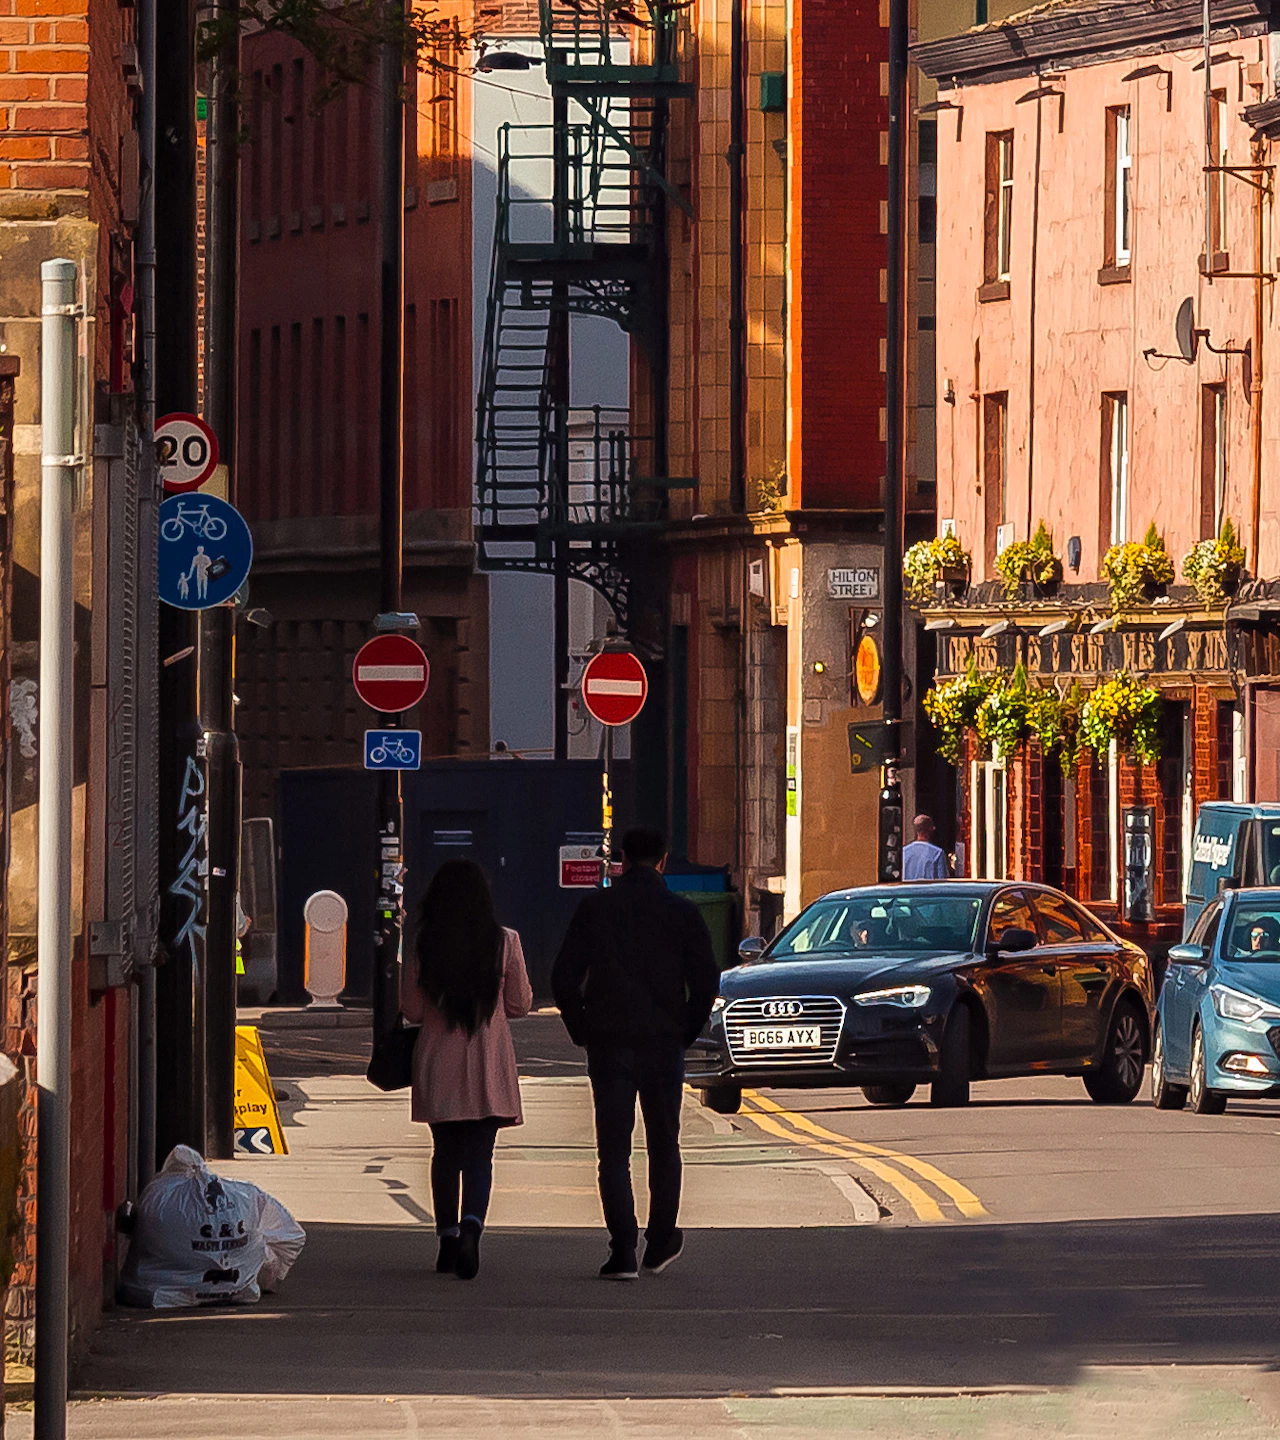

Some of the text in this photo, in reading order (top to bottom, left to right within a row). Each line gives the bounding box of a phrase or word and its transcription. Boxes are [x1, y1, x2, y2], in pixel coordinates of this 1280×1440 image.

[155, 435, 207, 467] 20
[832, 571, 876, 583] HILTON
[830, 584, 875, 596] STREET
[565, 863, 601, 872] Footpat
[750, 1029, 814, 1044] BG66 AYX
[235, 1102, 267, 1115] splay
